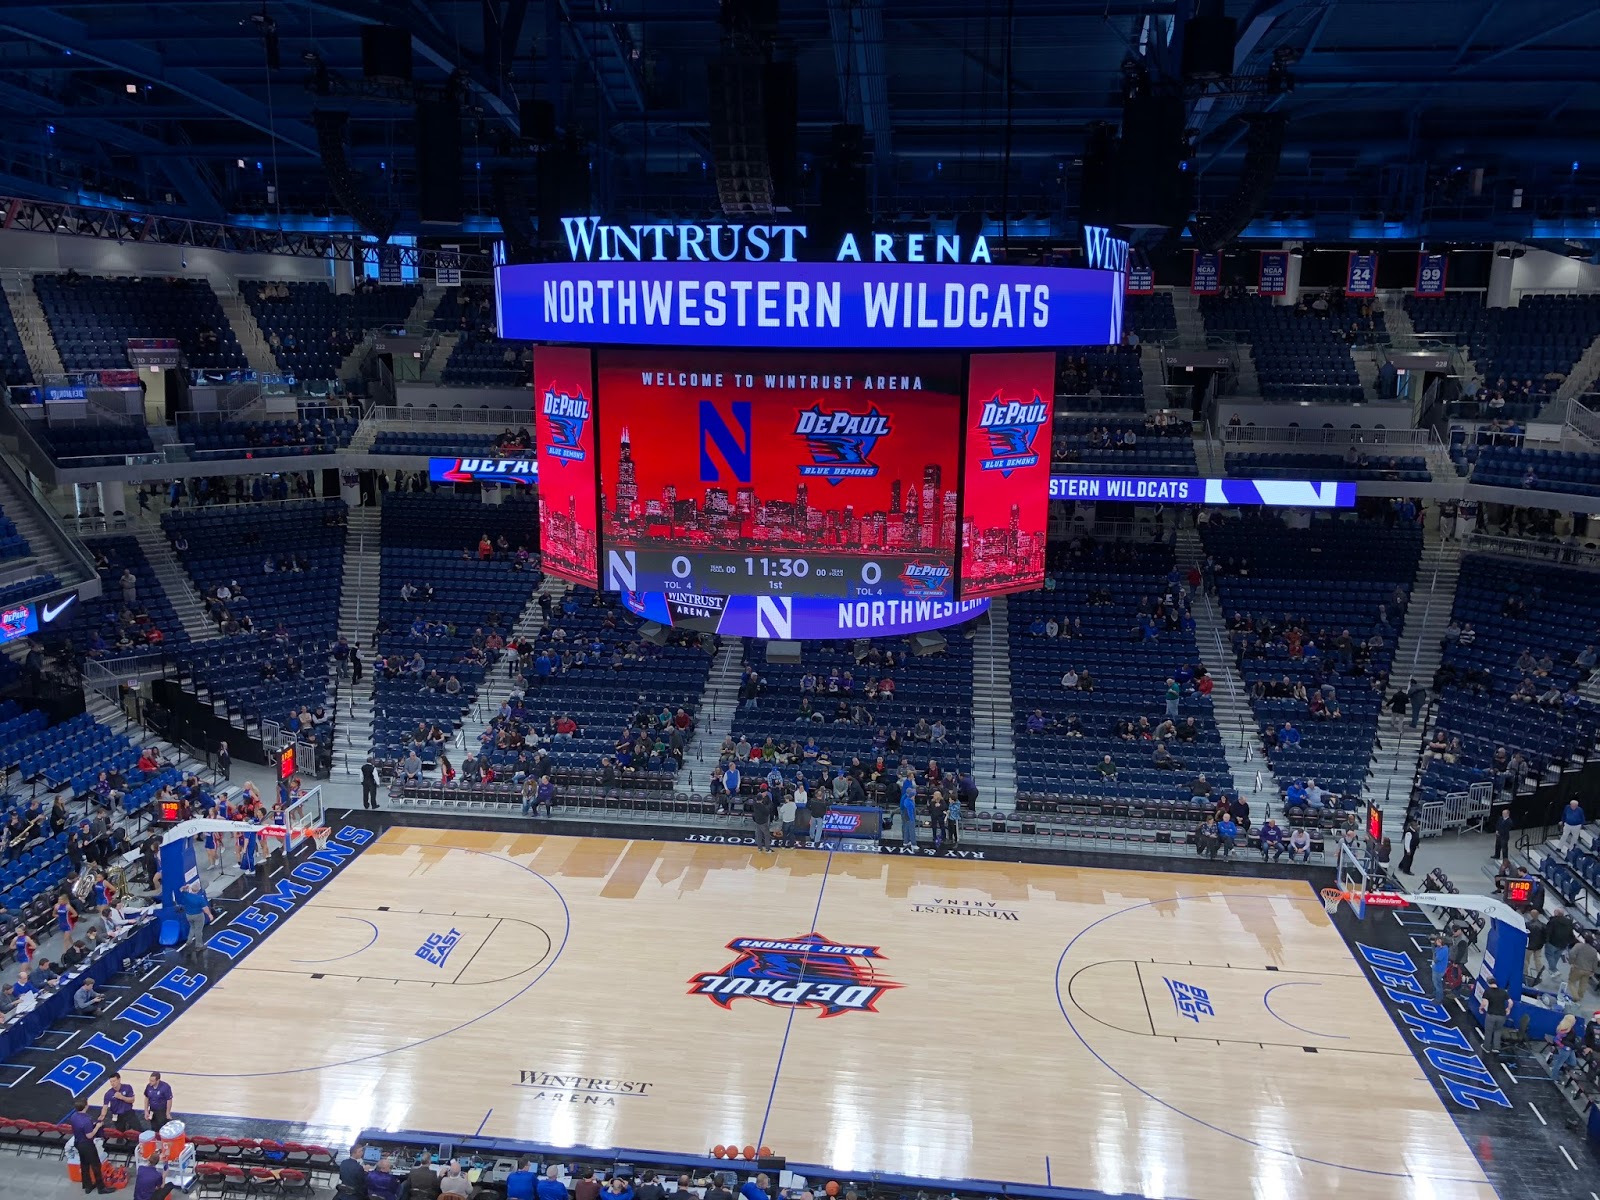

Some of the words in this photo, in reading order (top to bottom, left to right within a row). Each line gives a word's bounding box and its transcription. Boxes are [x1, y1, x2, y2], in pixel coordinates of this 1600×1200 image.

[561, 216, 807, 262] WINTRUST
[837, 233, 991, 263] ARENA
[1352, 269, 1370, 280] 24
[1422, 269, 1440, 280] 99
[543, 280, 841, 328] NORTHWESTERN
[863, 281, 1049, 328] WILDCATS
[642, 372, 723, 387] WELCOME
[735, 374, 753, 388] TO
[765, 375, 853, 389] WINTRUST
[864, 376, 922, 390] ARENA
[548, 447, 562, 456] BLUE
[563, 449, 584, 459] DEMONS
[985, 459, 1009, 469] BLUE
[1011, 457, 1036, 467] DEMONS
[834, 467, 874, 476] DEMONS
[1049, 480, 1100, 498] STERN
[1107, 481, 1189, 499] WILDCATS
[609, 551, 636, 591] N
[671, 556, 692, 578] 0
[726, 566, 736, 574] 00
[744, 557, 808, 577] 11:30
[816, 568, 826, 577] 00
[861, 562, 881, 584] 0
[664, 581, 681, 589] TOL
[769, 581, 783, 589] 1st
[668, 592, 723, 607] WINTRUST
[677, 605, 711, 618] ARENA
[685, 834, 755, 845] COURT
[842, 843, 916, 855] MARGE
[924, 848, 936, 856] &
[945, 850, 984, 859] RAY
[934, 898, 996, 907] ARENA
[911, 905, 1019, 921] WINTRUST
[415, 932, 443, 960] BIG
[426, 927, 461, 965] EAST
[739, 939, 814, 952] DEMONS
[819, 944, 868, 955] BLUE
[36, 965, 208, 1098] BLUE
[206, 826, 374, 959] DEMONS
[1171, 979, 1199, 1023] EAST
[1189, 985, 1215, 1016] BIG
[519, 1070, 653, 1094] WINTRUST
[533, 1091, 616, 1106] ARENA
